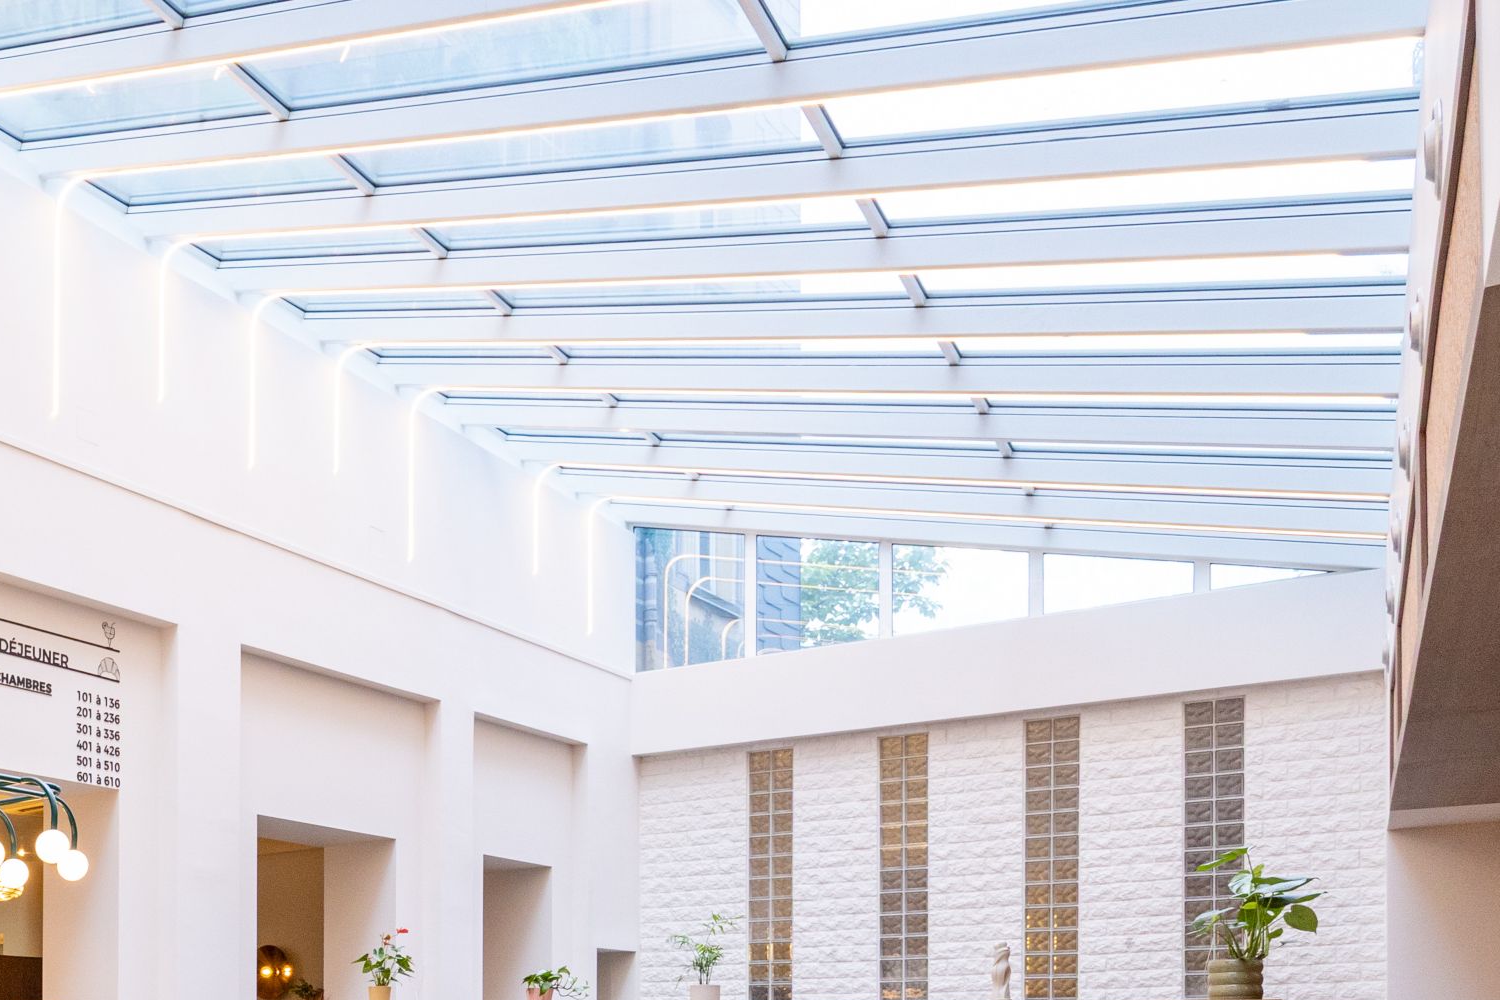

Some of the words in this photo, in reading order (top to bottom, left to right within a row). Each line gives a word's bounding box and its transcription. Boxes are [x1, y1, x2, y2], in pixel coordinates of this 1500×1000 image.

[77, 691, 92, 703] 101
[96, 695, 101, 705] à
[104, 697, 120, 709] 136
[77, 706, 92, 719] 201
[96, 710, 101, 720] à
[104, 712, 120, 724] 236
[77, 723, 92, 735] 301
[96, 727, 101, 737] à
[104, 729, 120, 741] 336
[77, 740, 92, 752] 401
[96, 743, 101, 753] à
[104, 745, 120, 757] 426
[77, 756, 92, 768] 501
[96, 759, 101, 769] à
[104, 761, 120, 772] 510
[77, 772, 92, 783] 601
[96, 774, 101, 785] à
[104, 776, 120, 788] 610
